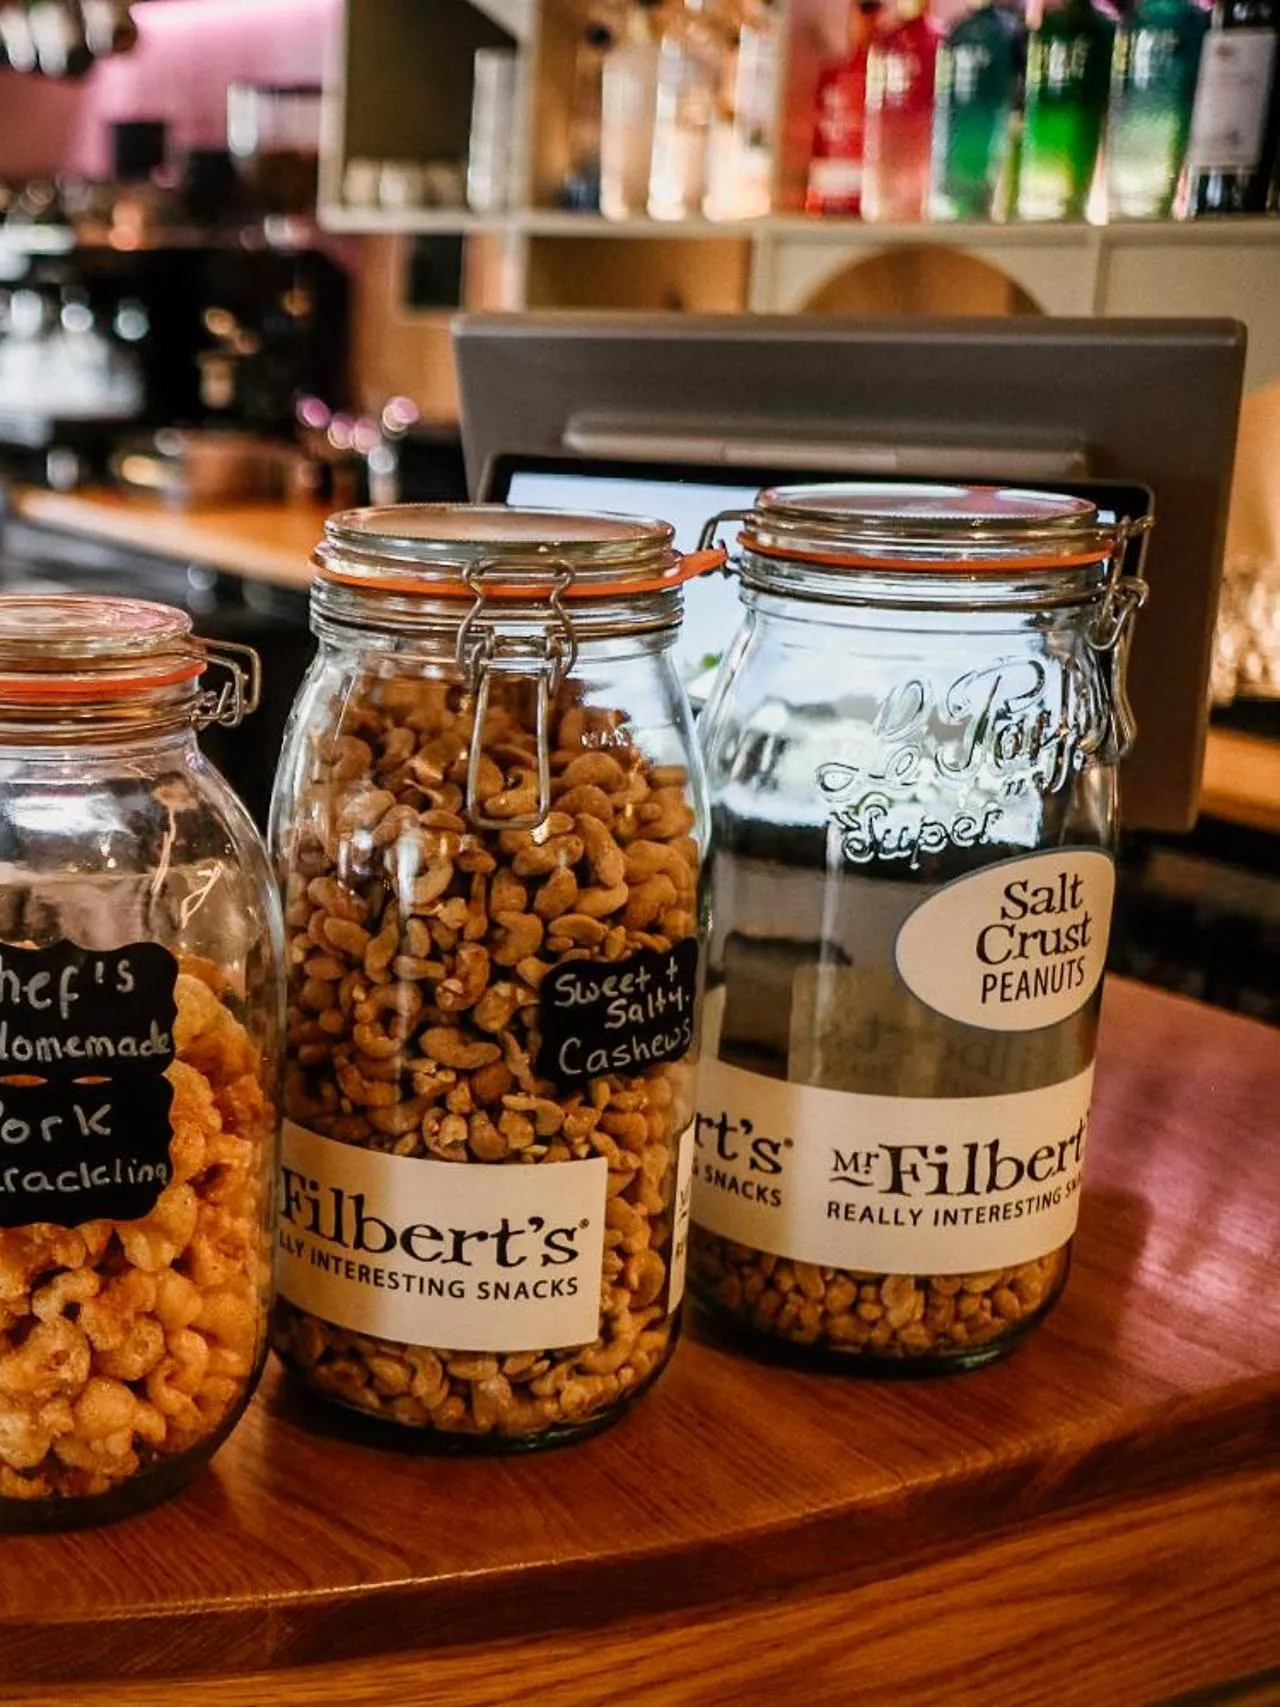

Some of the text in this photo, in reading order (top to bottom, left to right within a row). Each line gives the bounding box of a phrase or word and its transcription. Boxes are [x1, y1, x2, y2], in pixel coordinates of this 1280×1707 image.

[1000, 873, 1083, 920] Salt
[976, 916, 1092, 965] Crust
[554, 965, 651, 1007] Sweet
[980, 956, 1085, 1004] PEANUTS
[559, 1018, 691, 1075] Cashews
[695, 1111, 783, 1175] rt's
[832, 1148, 878, 1177] Mr
[704, 1164, 782, 1208] SNACKS
[827, 1187, 1061, 1228] REALLY INTERESTING
[280, 1166, 580, 1267] Filbert's
[309, 1247, 465, 1299] INTERESTING
[477, 1277, 579, 1300] SNACKS
